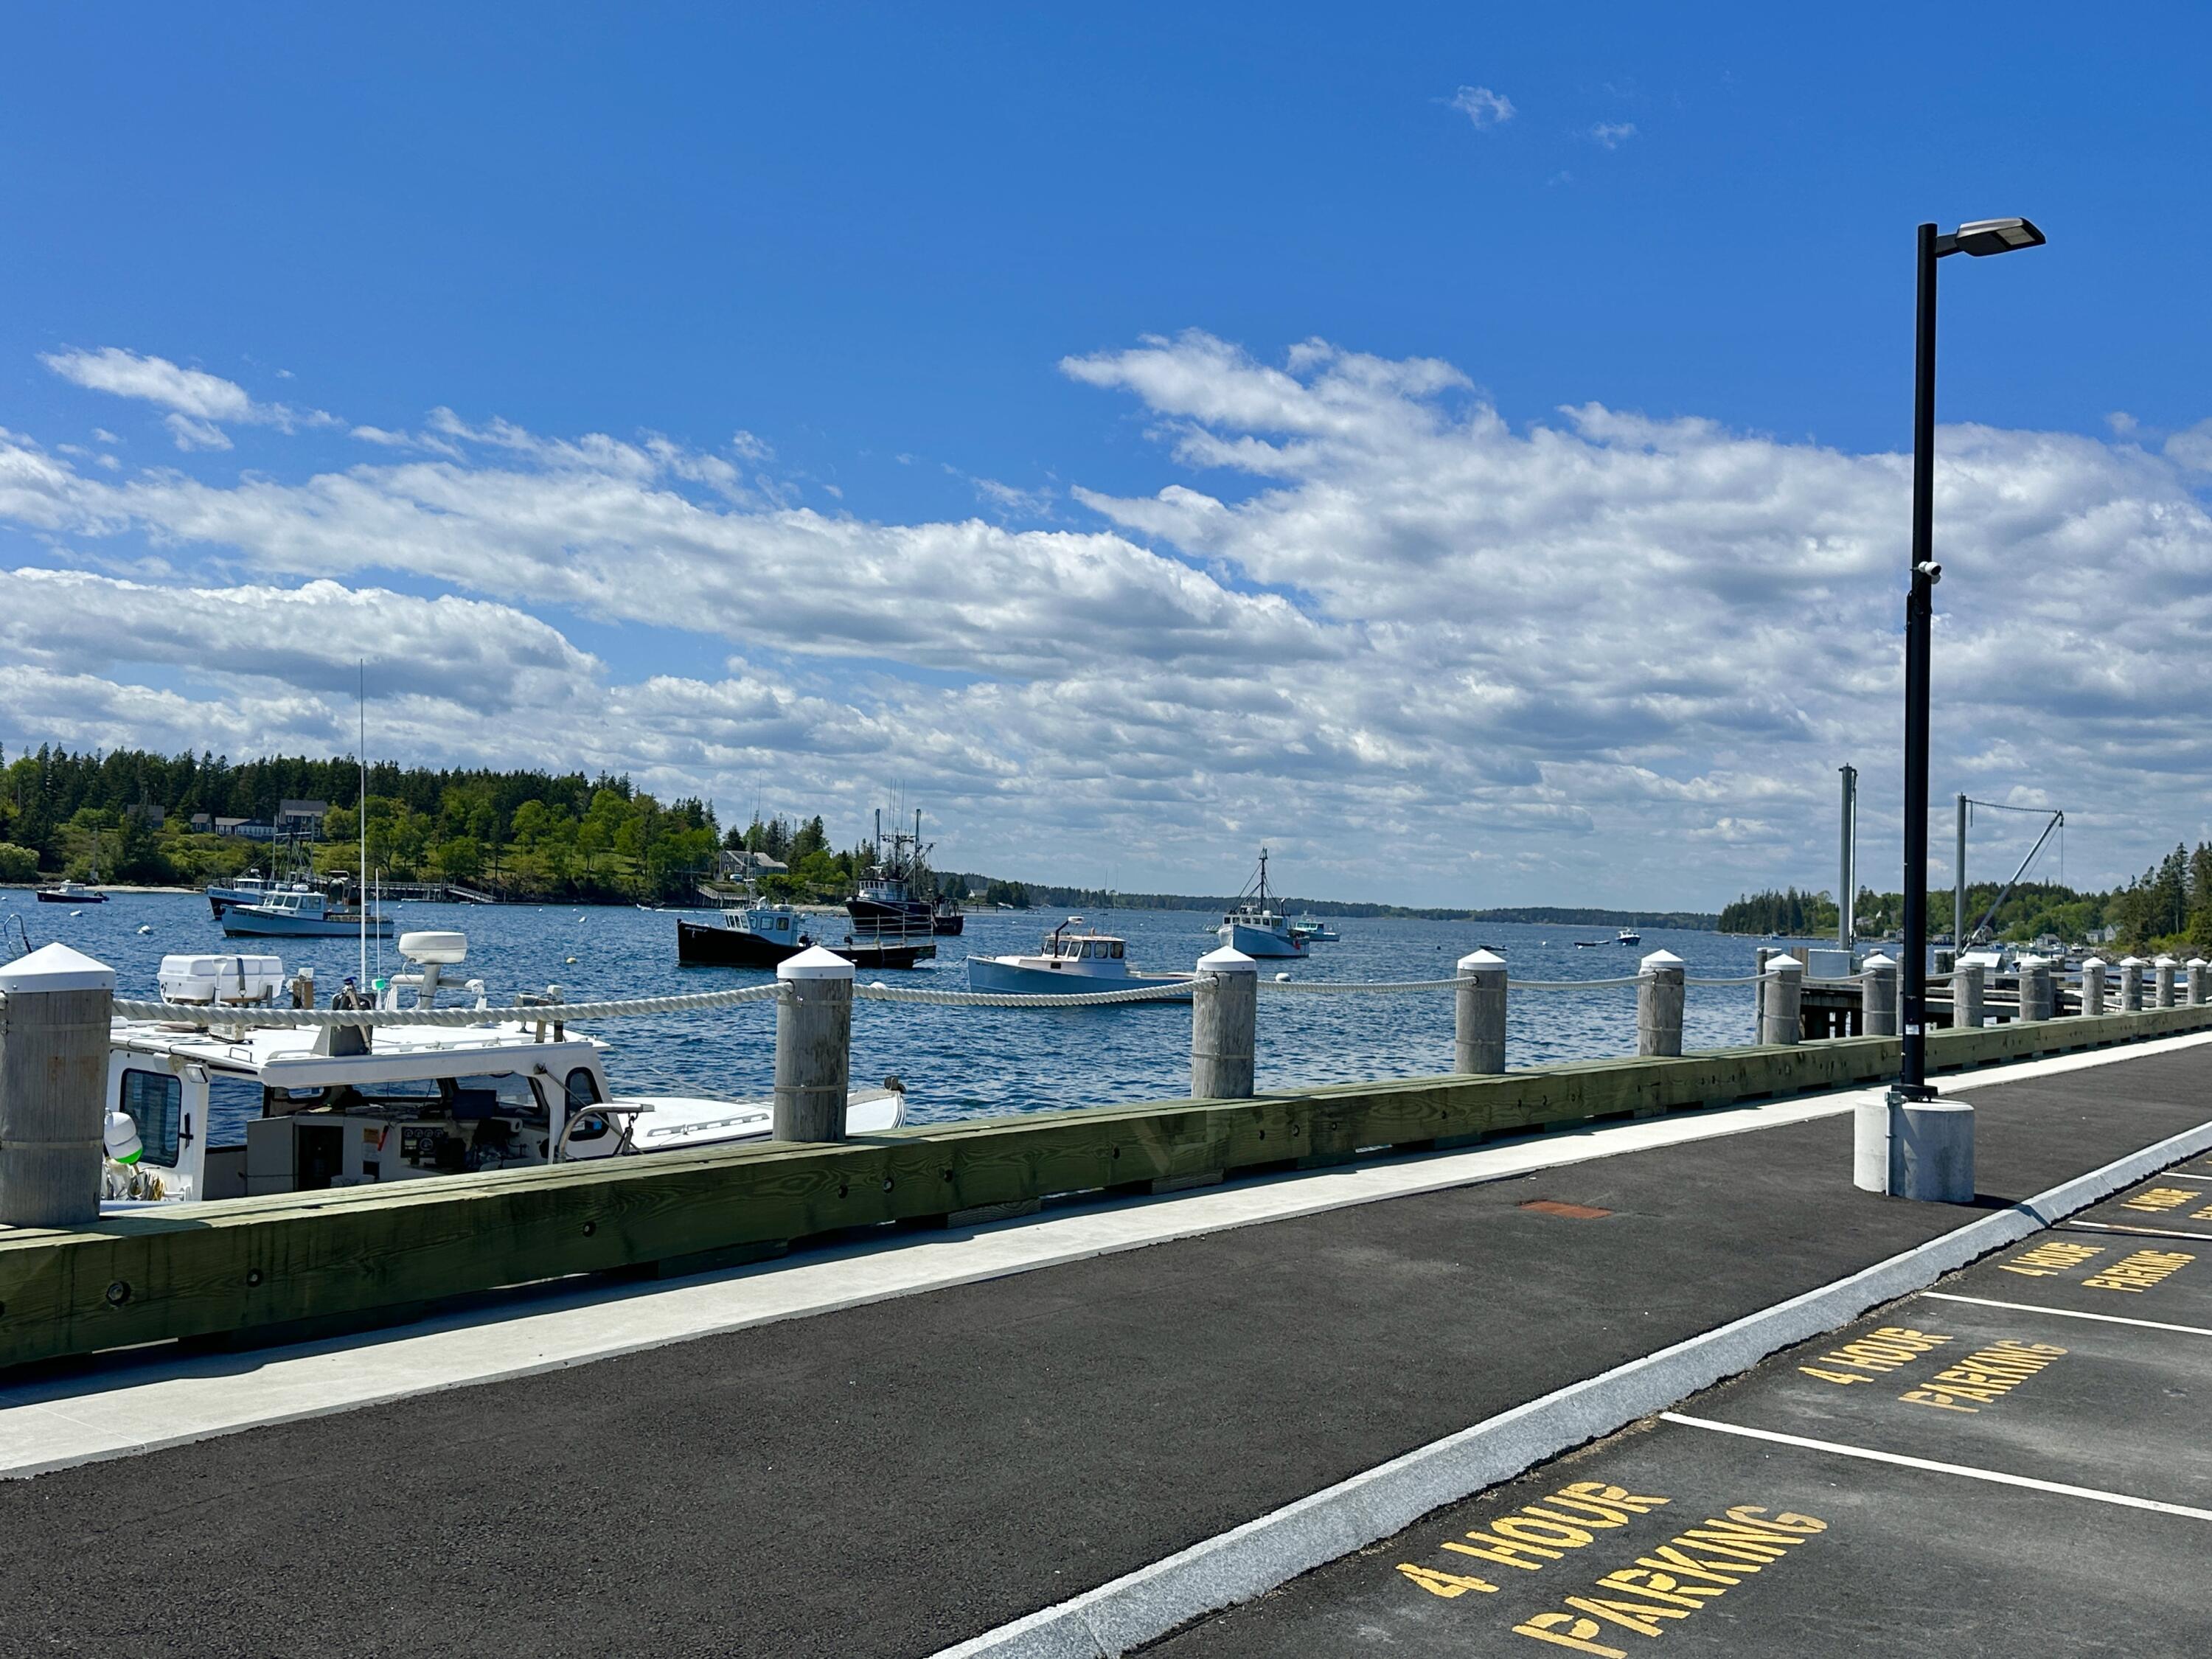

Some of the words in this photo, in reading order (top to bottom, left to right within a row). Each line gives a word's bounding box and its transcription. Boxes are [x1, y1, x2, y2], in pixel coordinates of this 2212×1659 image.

[1998, 1265, 2058, 1276] 4
[2010, 1242, 2106, 1269] HOUR
[2081, 1250, 2196, 1293] PARKING
[1818, 1326, 1954, 1372] HOUR
[1798, 1366, 1874, 1385] 4
[1897, 1339, 2068, 1413] PARKING
[1440, 1481, 1672, 1571] HOUR
[1395, 1562, 1500, 1599] 4
[1511, 1505, 1828, 1659] PARKING
